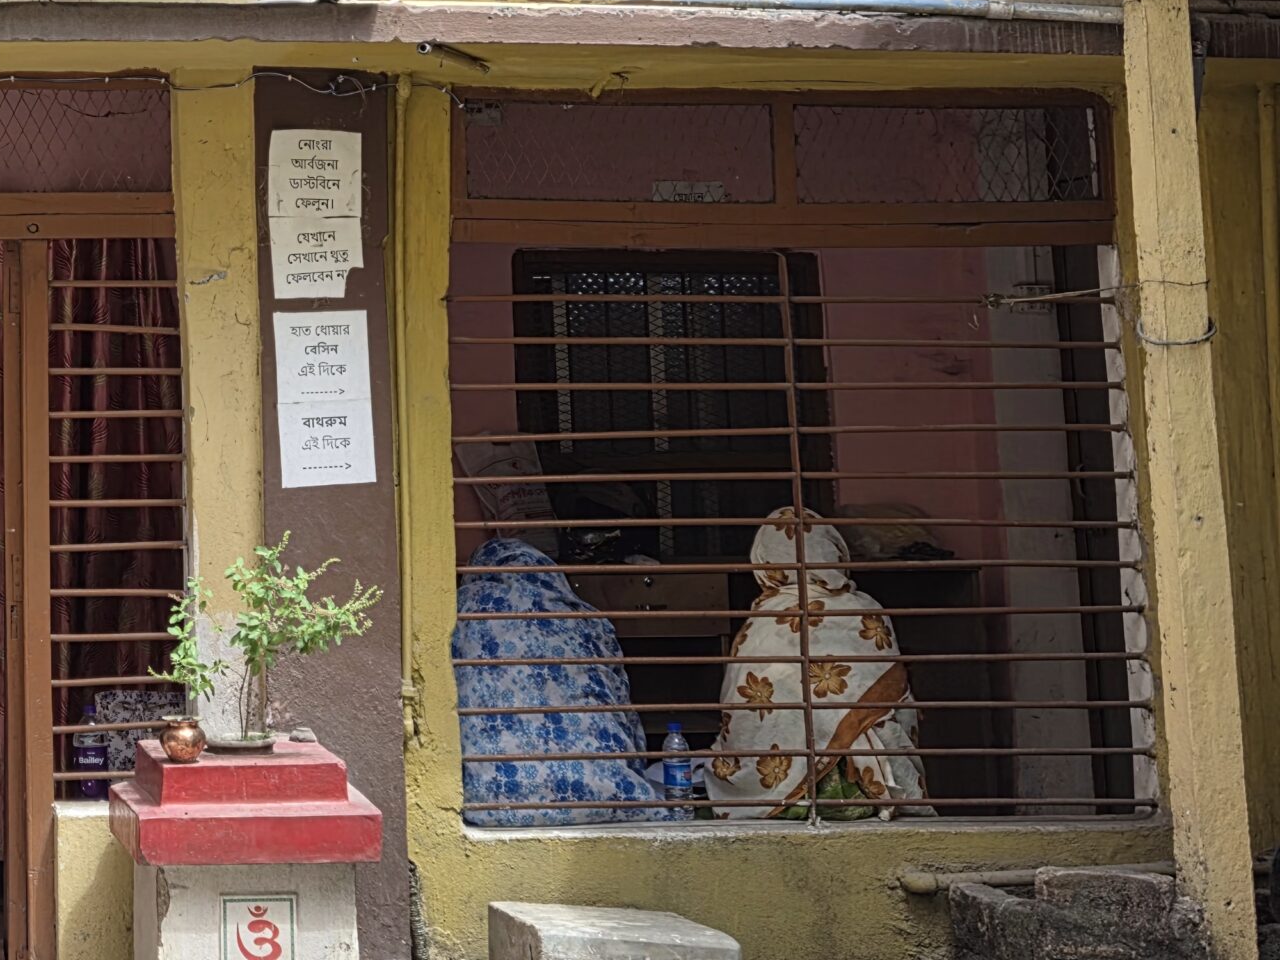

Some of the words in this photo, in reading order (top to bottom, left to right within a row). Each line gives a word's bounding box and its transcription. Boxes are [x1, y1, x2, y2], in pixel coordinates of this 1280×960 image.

[297, 139, 332, 151] নোংরা
[289, 175, 341, 190] ডাস্টবিনে
[295, 197, 334, 212] ফেলুন।
[297, 230, 336, 244] যেখানে
[287, 250, 328, 265] সেখানে
[330, 248, 349, 264] থুতু
[286, 269, 333, 285] ফেলবেন
[335, 268, 348, 280] ন
[290, 325, 311, 337] হাত
[315, 324, 350, 337] ধোয়ার
[304, 342, 339, 355] বেসিন
[297, 362, 316, 377] এই
[318, 361, 347, 376] দিকে
[302, 415, 348, 429] বাথরুম
[301, 435, 320, 451] এই
[322, 434, 351, 450] দিকে
